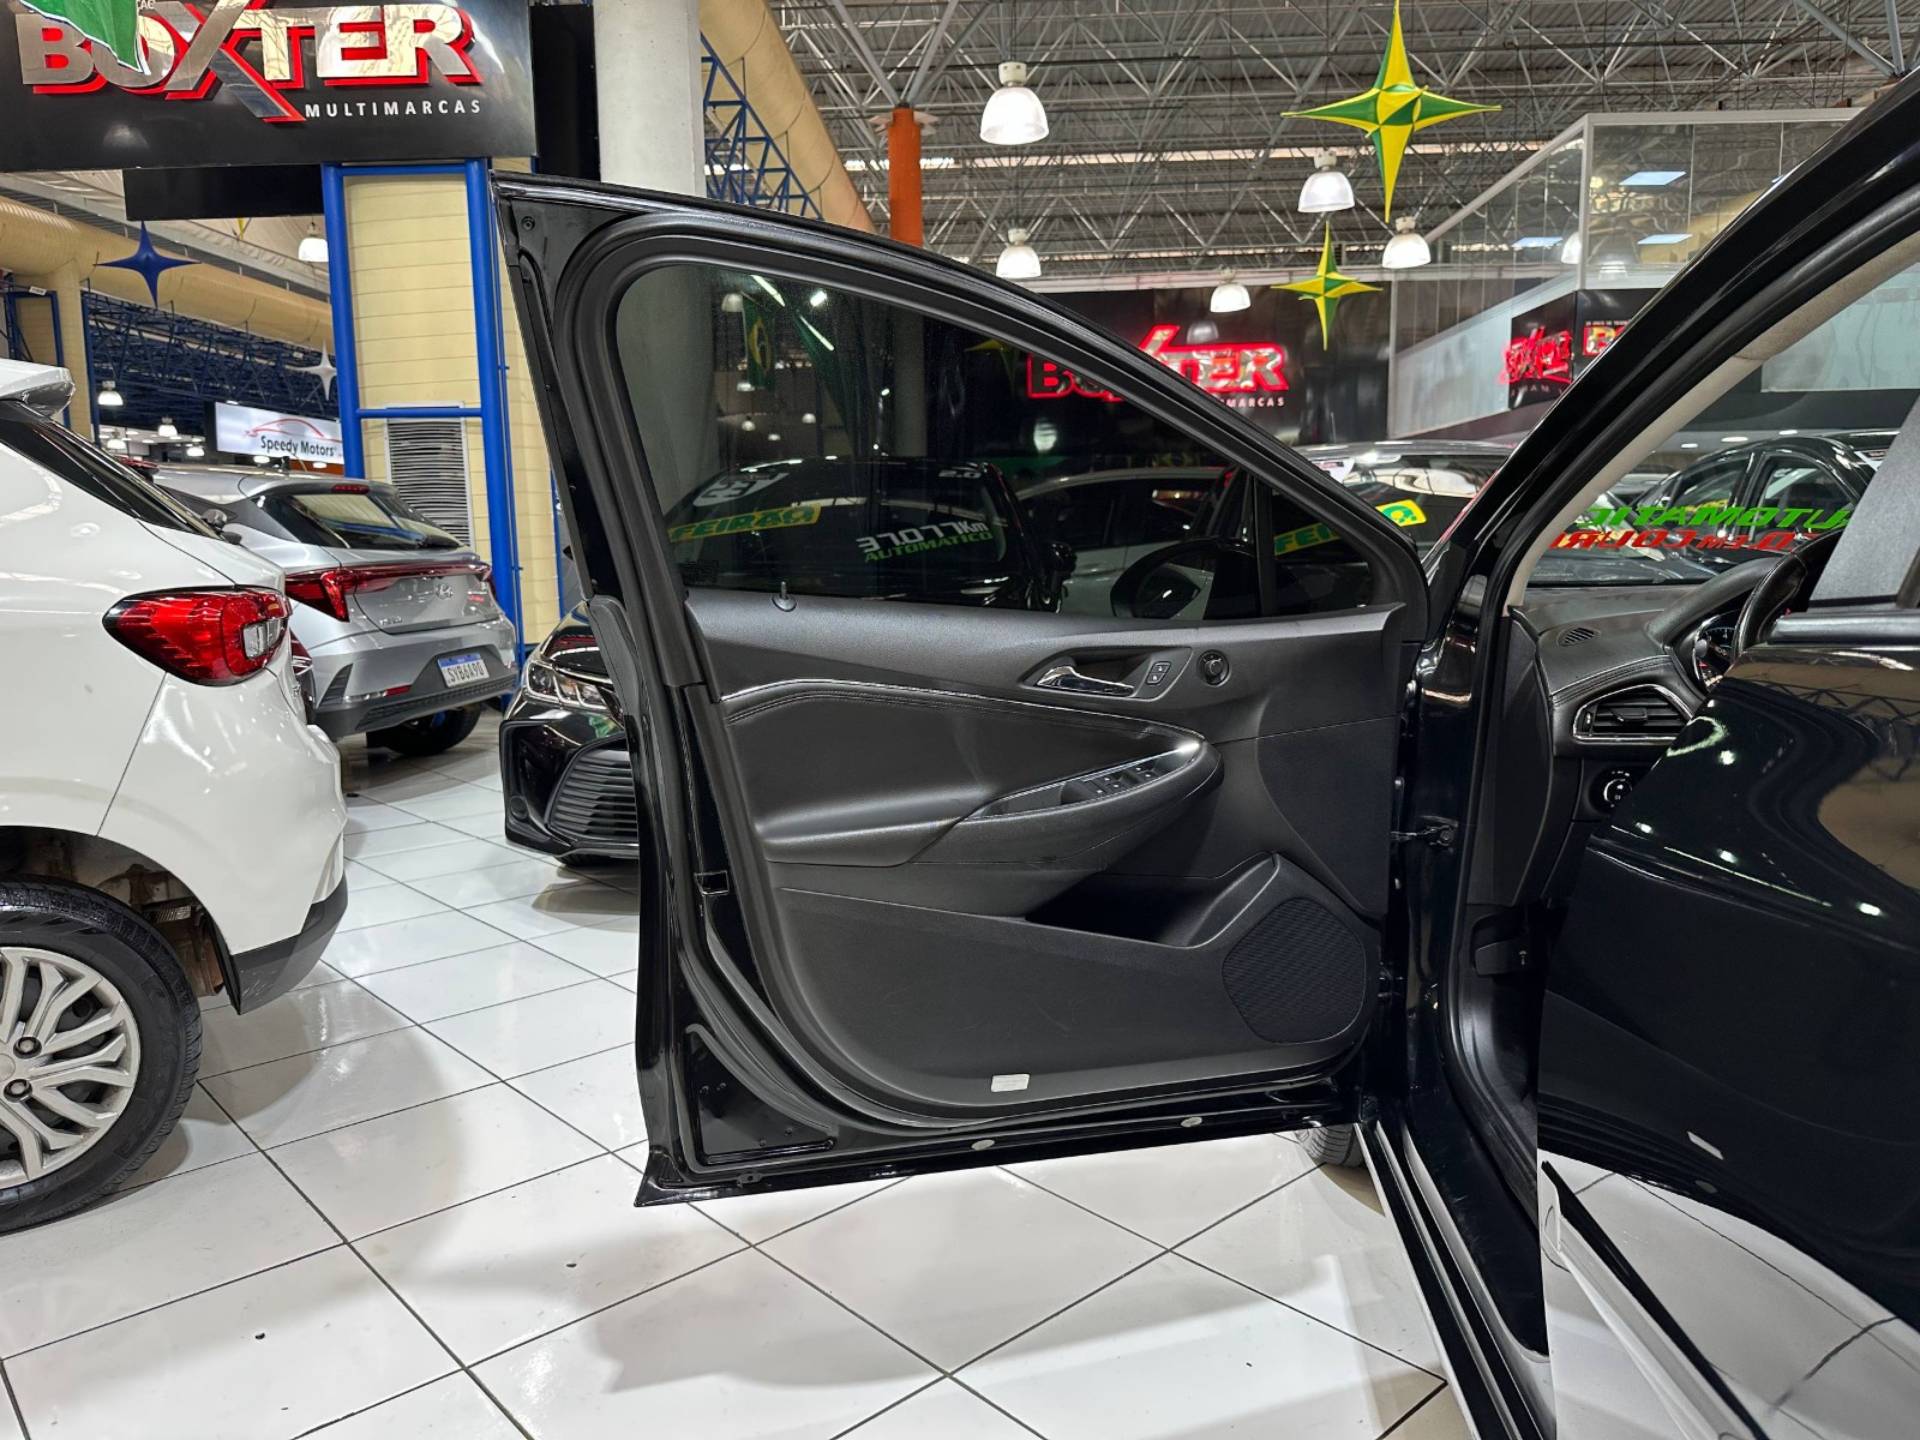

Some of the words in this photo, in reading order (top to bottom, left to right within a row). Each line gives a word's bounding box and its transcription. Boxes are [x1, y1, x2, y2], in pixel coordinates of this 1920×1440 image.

[305, 101, 482, 118] MULTIMARCAS
[260, 435, 298, 455] Speedy
[300, 442, 334, 457] Motors
